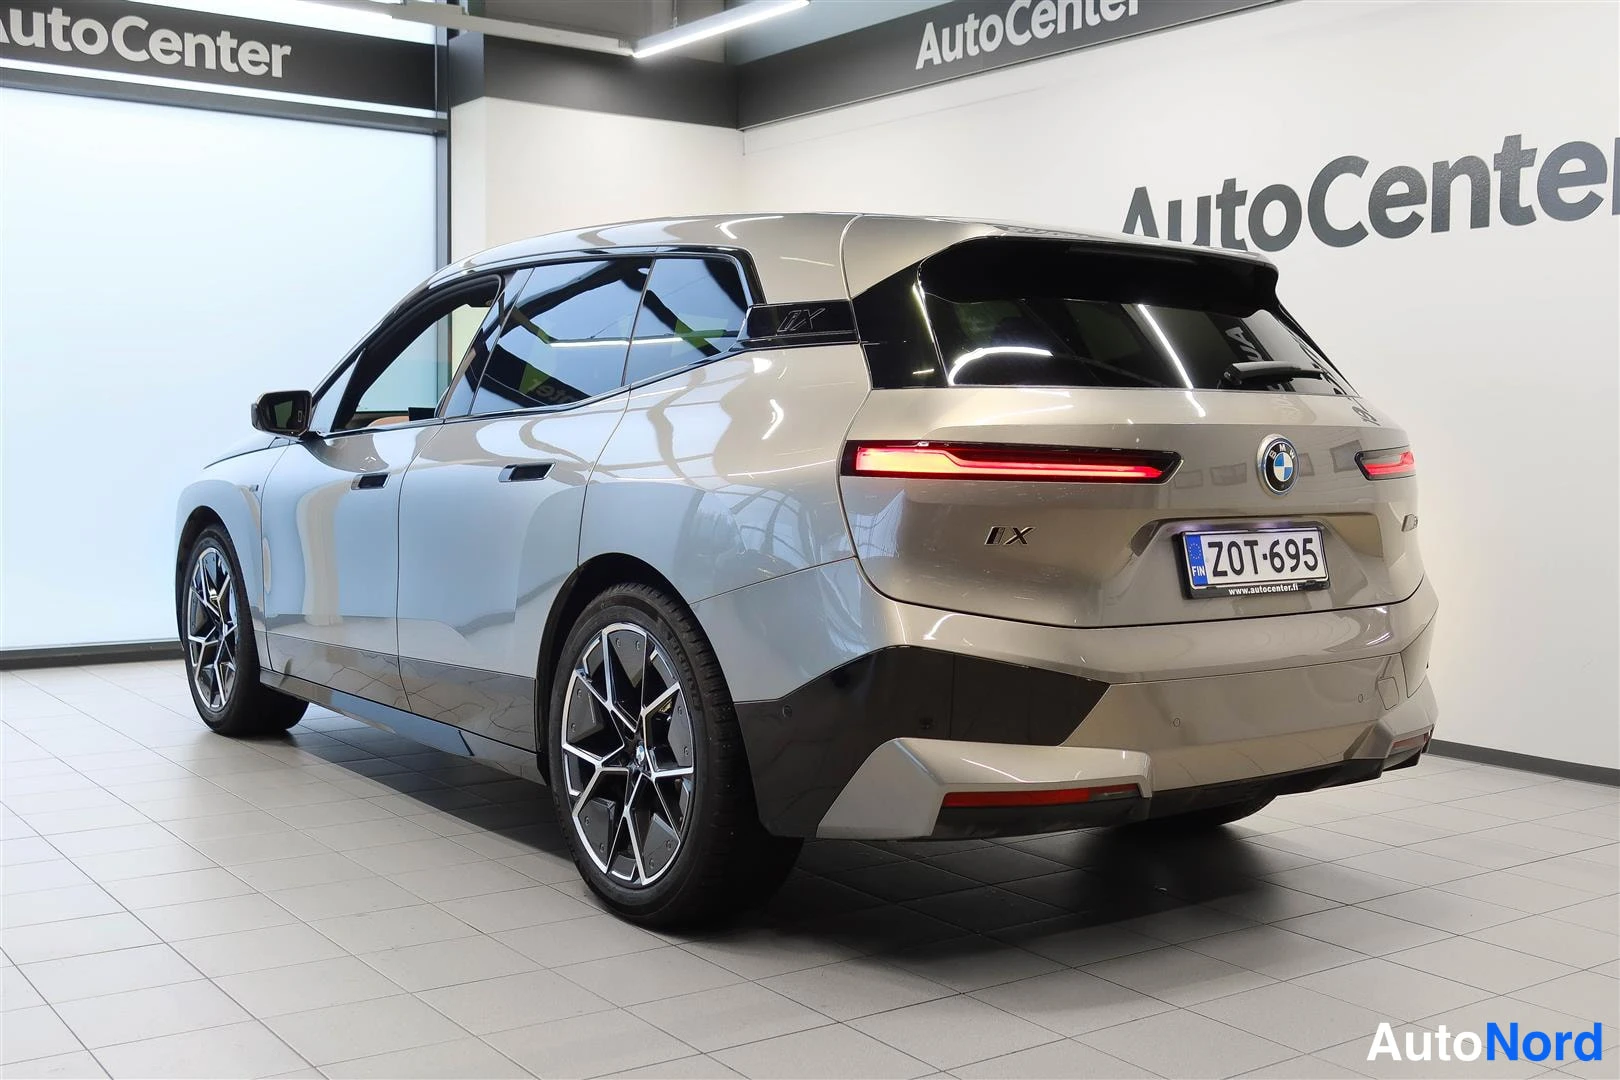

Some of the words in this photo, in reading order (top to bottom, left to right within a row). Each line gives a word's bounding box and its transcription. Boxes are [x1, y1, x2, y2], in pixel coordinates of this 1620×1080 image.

[0, 7, 292, 78] utoCenter
[1269, 443, 1296, 460] BMW
[1207, 537, 1319, 577] ZOT-695
[1191, 565, 1206, 577] FIN
[1228, 583, 1299, 595] www.autocenter.fi
